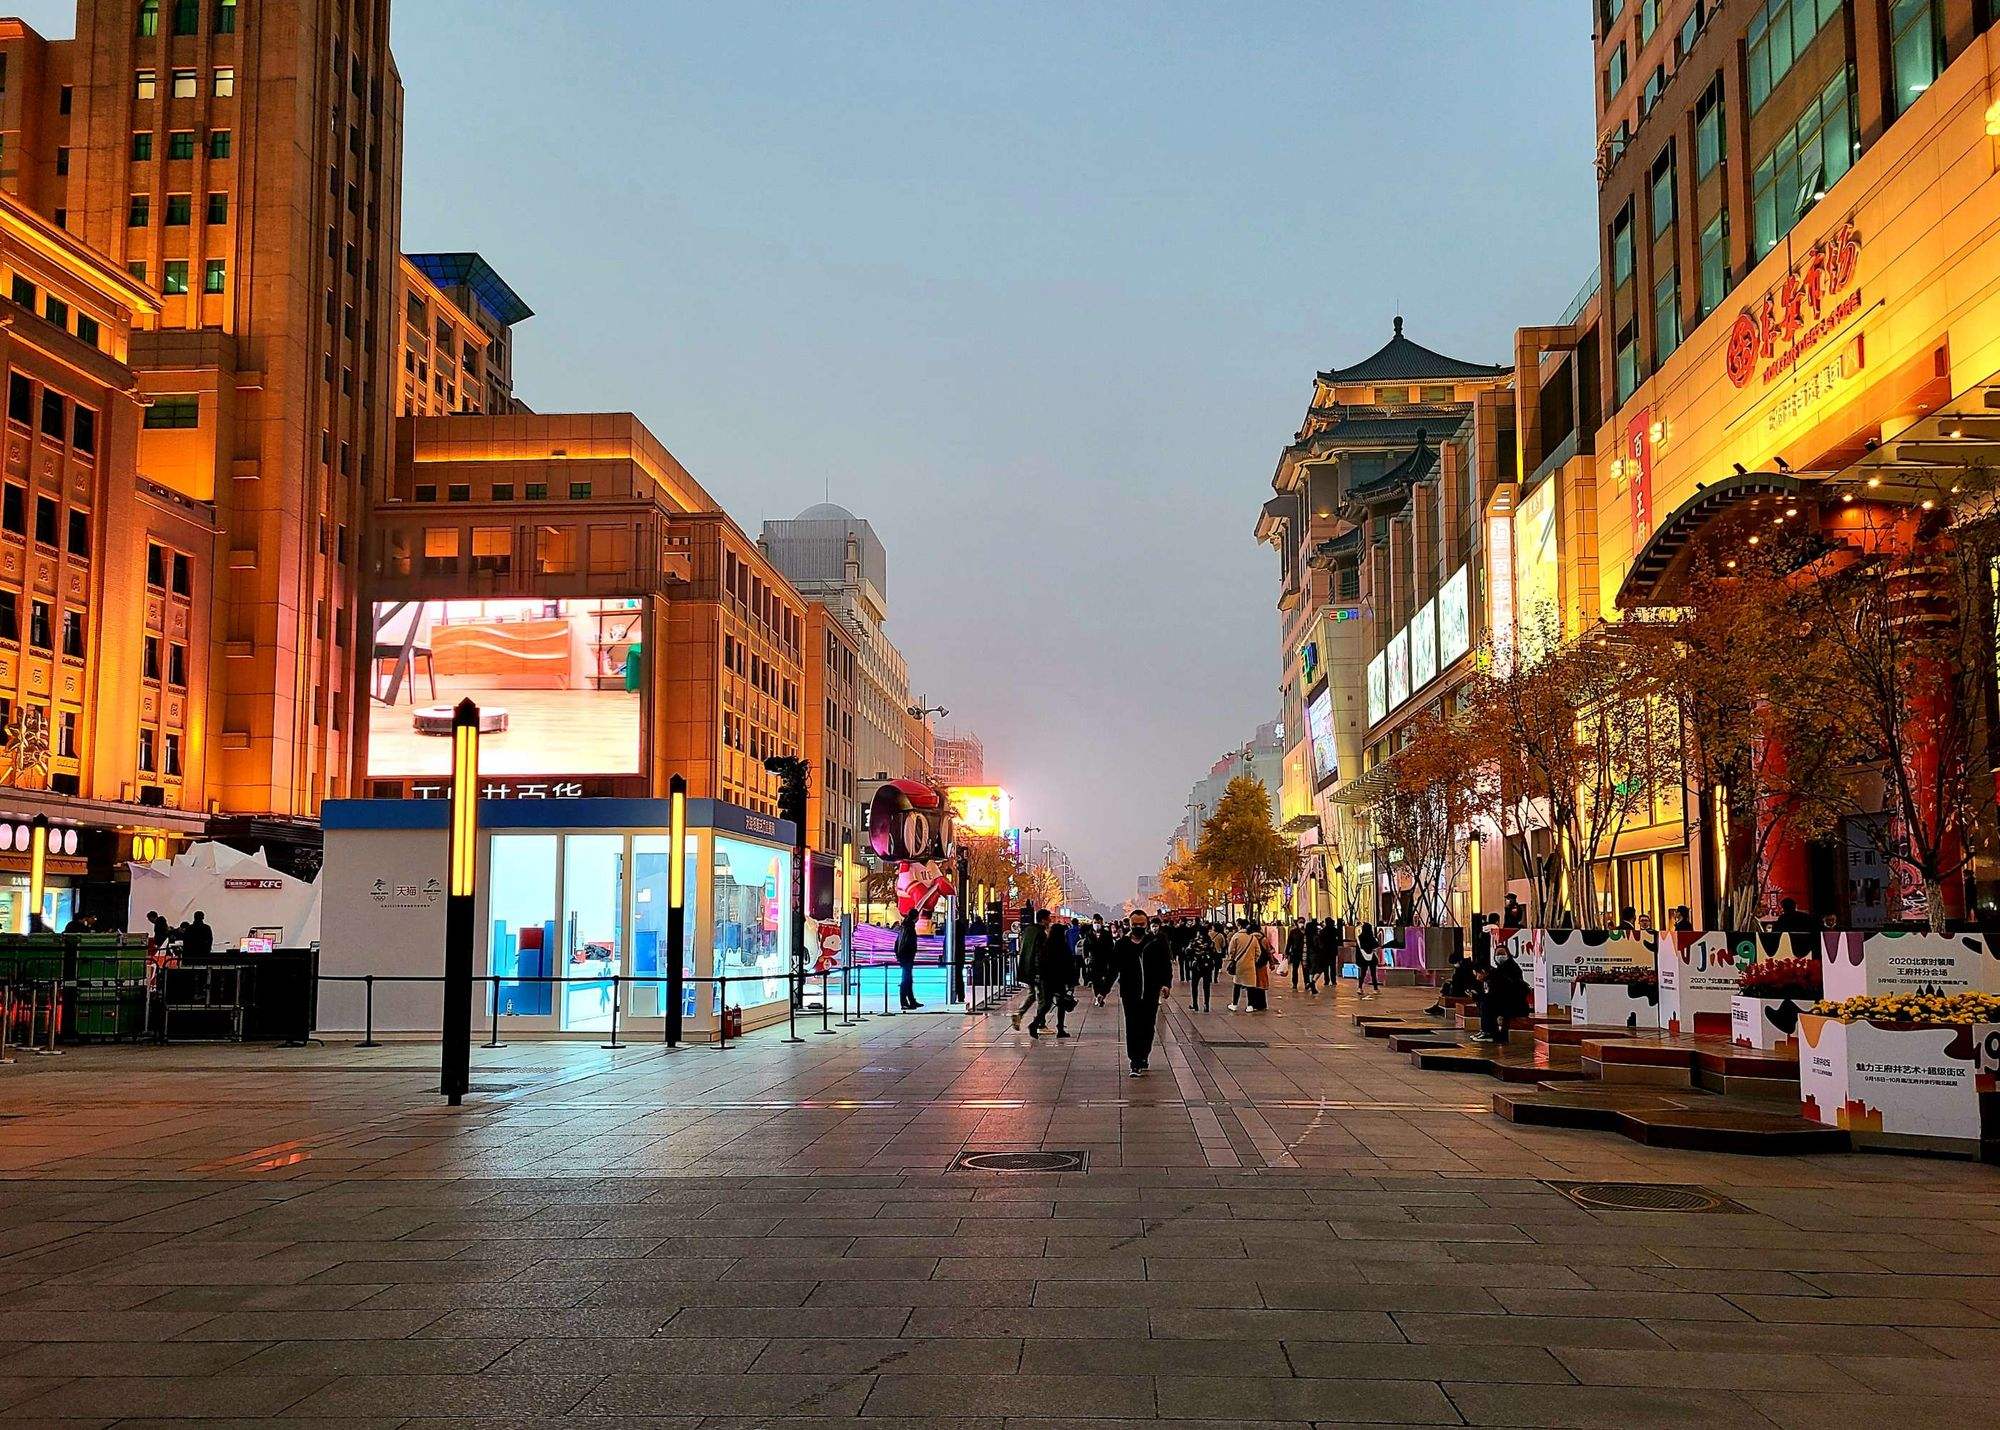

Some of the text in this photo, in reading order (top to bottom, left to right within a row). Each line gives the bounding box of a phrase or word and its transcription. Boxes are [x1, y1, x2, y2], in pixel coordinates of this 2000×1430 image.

[259, 880, 281, 888] KFC
[396, 886, 417, 897] 天猫
[1896, 967, 1948, 977] 王府井分会场
[1855, 1062, 1966, 1077] 魅力王府井艺术+超级街区
